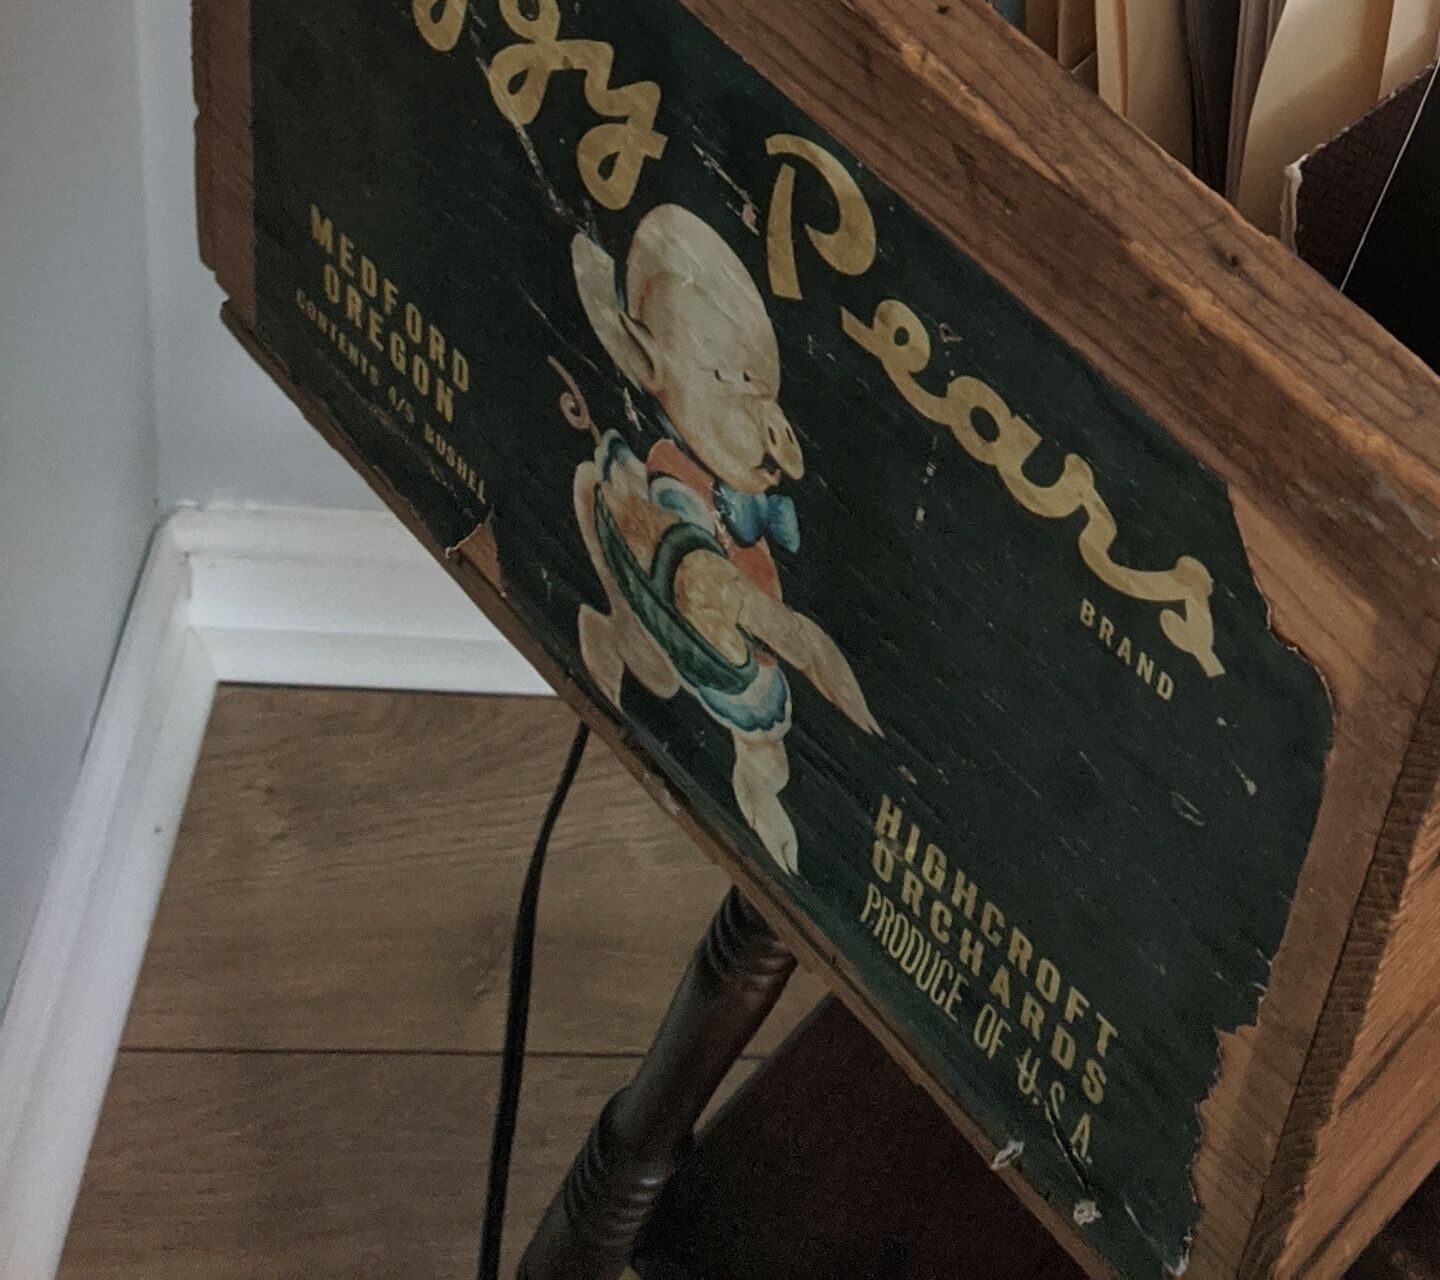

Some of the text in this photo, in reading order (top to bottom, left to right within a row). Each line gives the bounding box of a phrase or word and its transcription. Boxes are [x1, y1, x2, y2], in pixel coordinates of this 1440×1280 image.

[311, 203, 470, 393] MEDFORD
[324, 264, 453, 423] OREGON
[765, 134, 1225, 677] Pears
[1079, 599, 1175, 702] BRAND
[861, 884, 972, 1022] PRODUCE
[973, 1002, 1012, 1061] OF
[871, 840, 1108, 1105] ORCHARDS
[876, 794, 1119, 1060] HIGHCROFT
